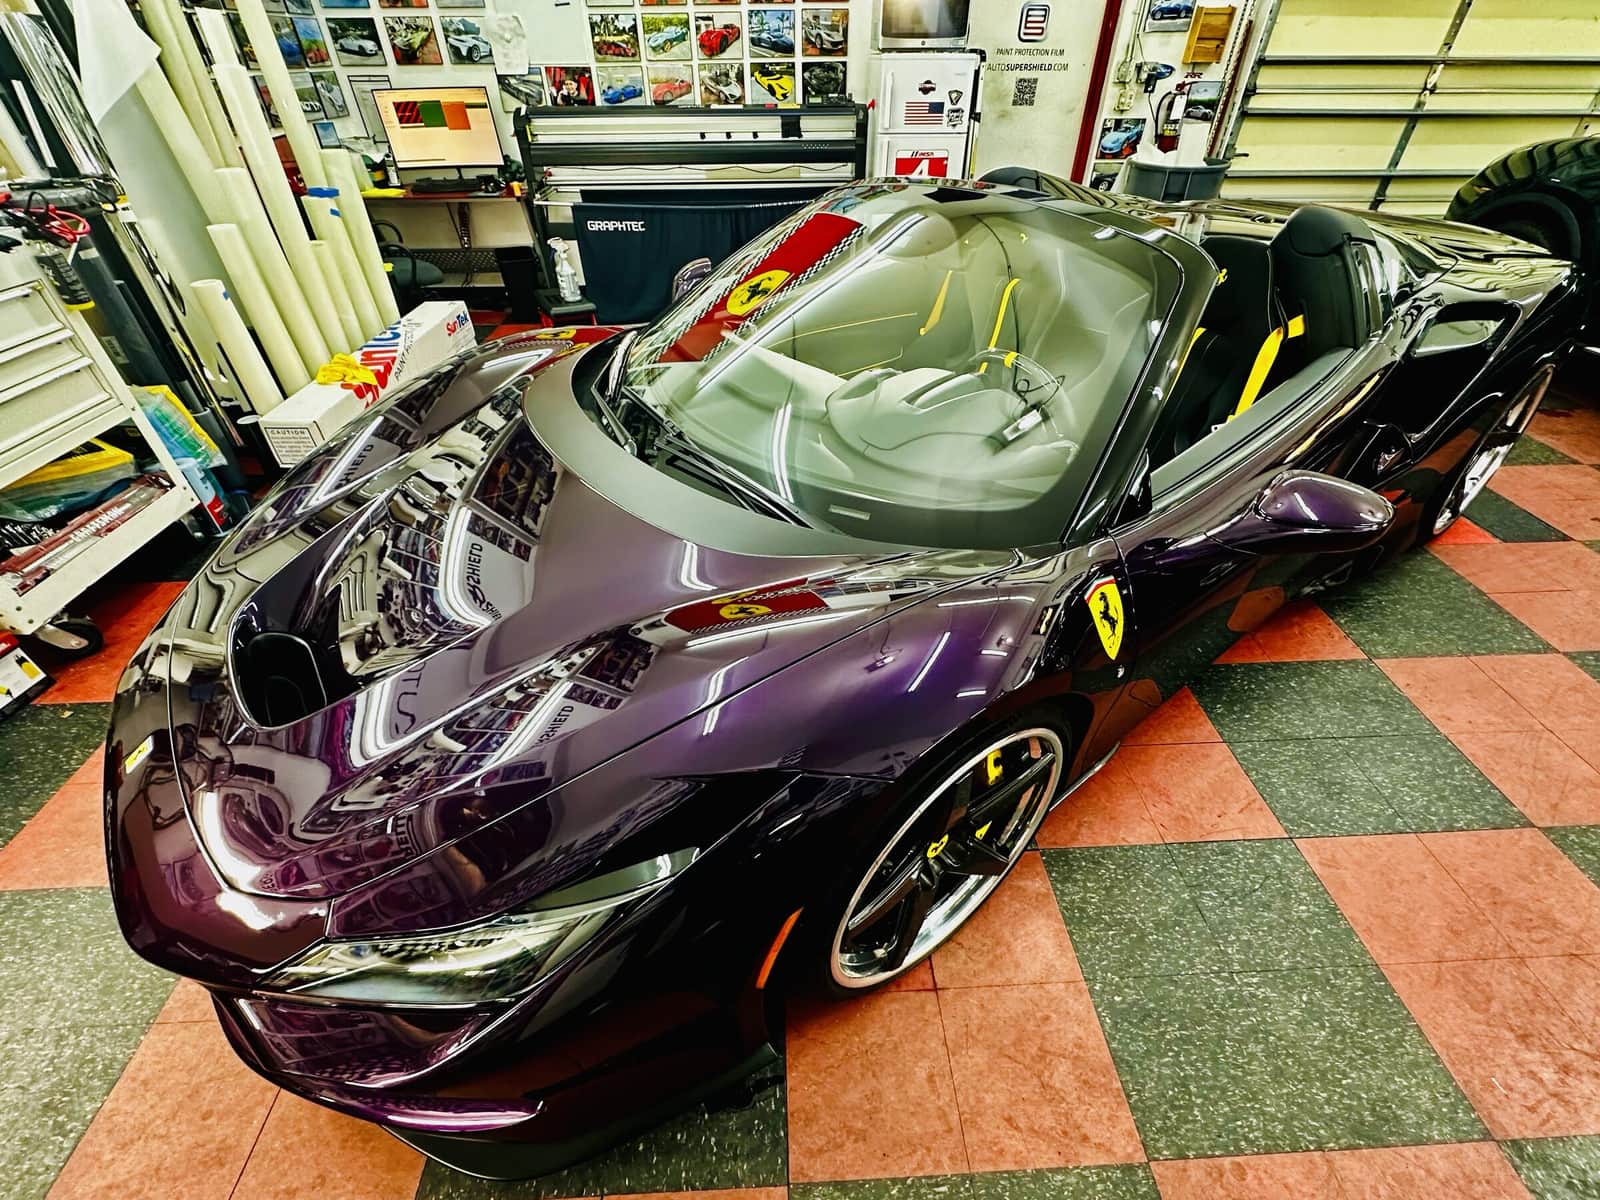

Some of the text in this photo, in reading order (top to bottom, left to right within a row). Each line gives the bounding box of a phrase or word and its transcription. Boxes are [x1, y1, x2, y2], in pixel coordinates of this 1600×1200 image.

[996, 48, 1065, 56] PAINT PROTECTION FILM
[586, 220, 646, 232] GRAPHTEC
